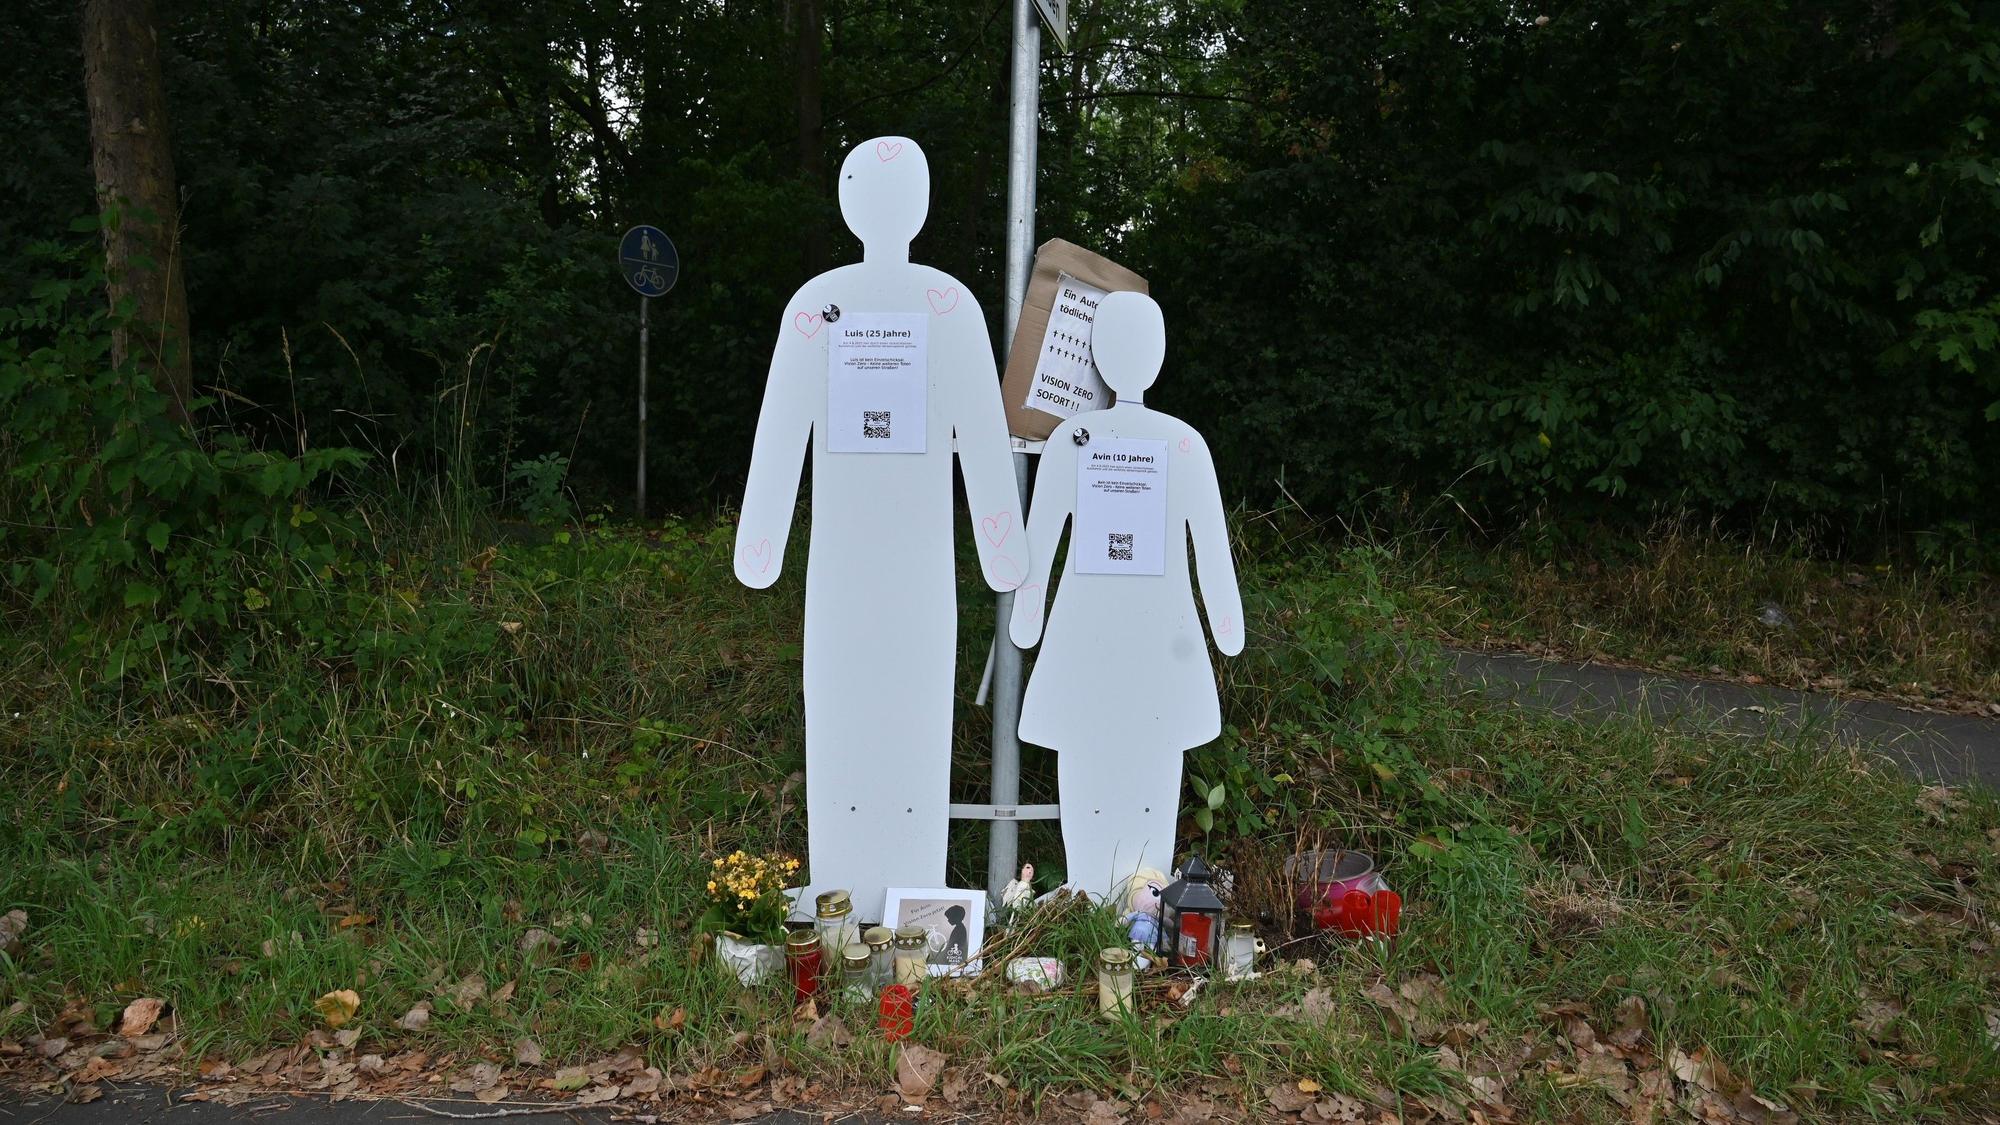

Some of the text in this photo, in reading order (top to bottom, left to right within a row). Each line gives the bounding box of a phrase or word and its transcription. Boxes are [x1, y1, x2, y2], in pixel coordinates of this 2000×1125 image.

[1063, 288, 1077, 301] Ein
[866, 330, 881, 338] (25
[882, 330, 911, 338] Jahre)
[1041, 373, 1094, 401] VISION ZERO
[1036, 388, 1070, 408] SOFORT
[1113, 454, 1127, 462] (10
[1128, 455, 1154, 463] Jahre)
